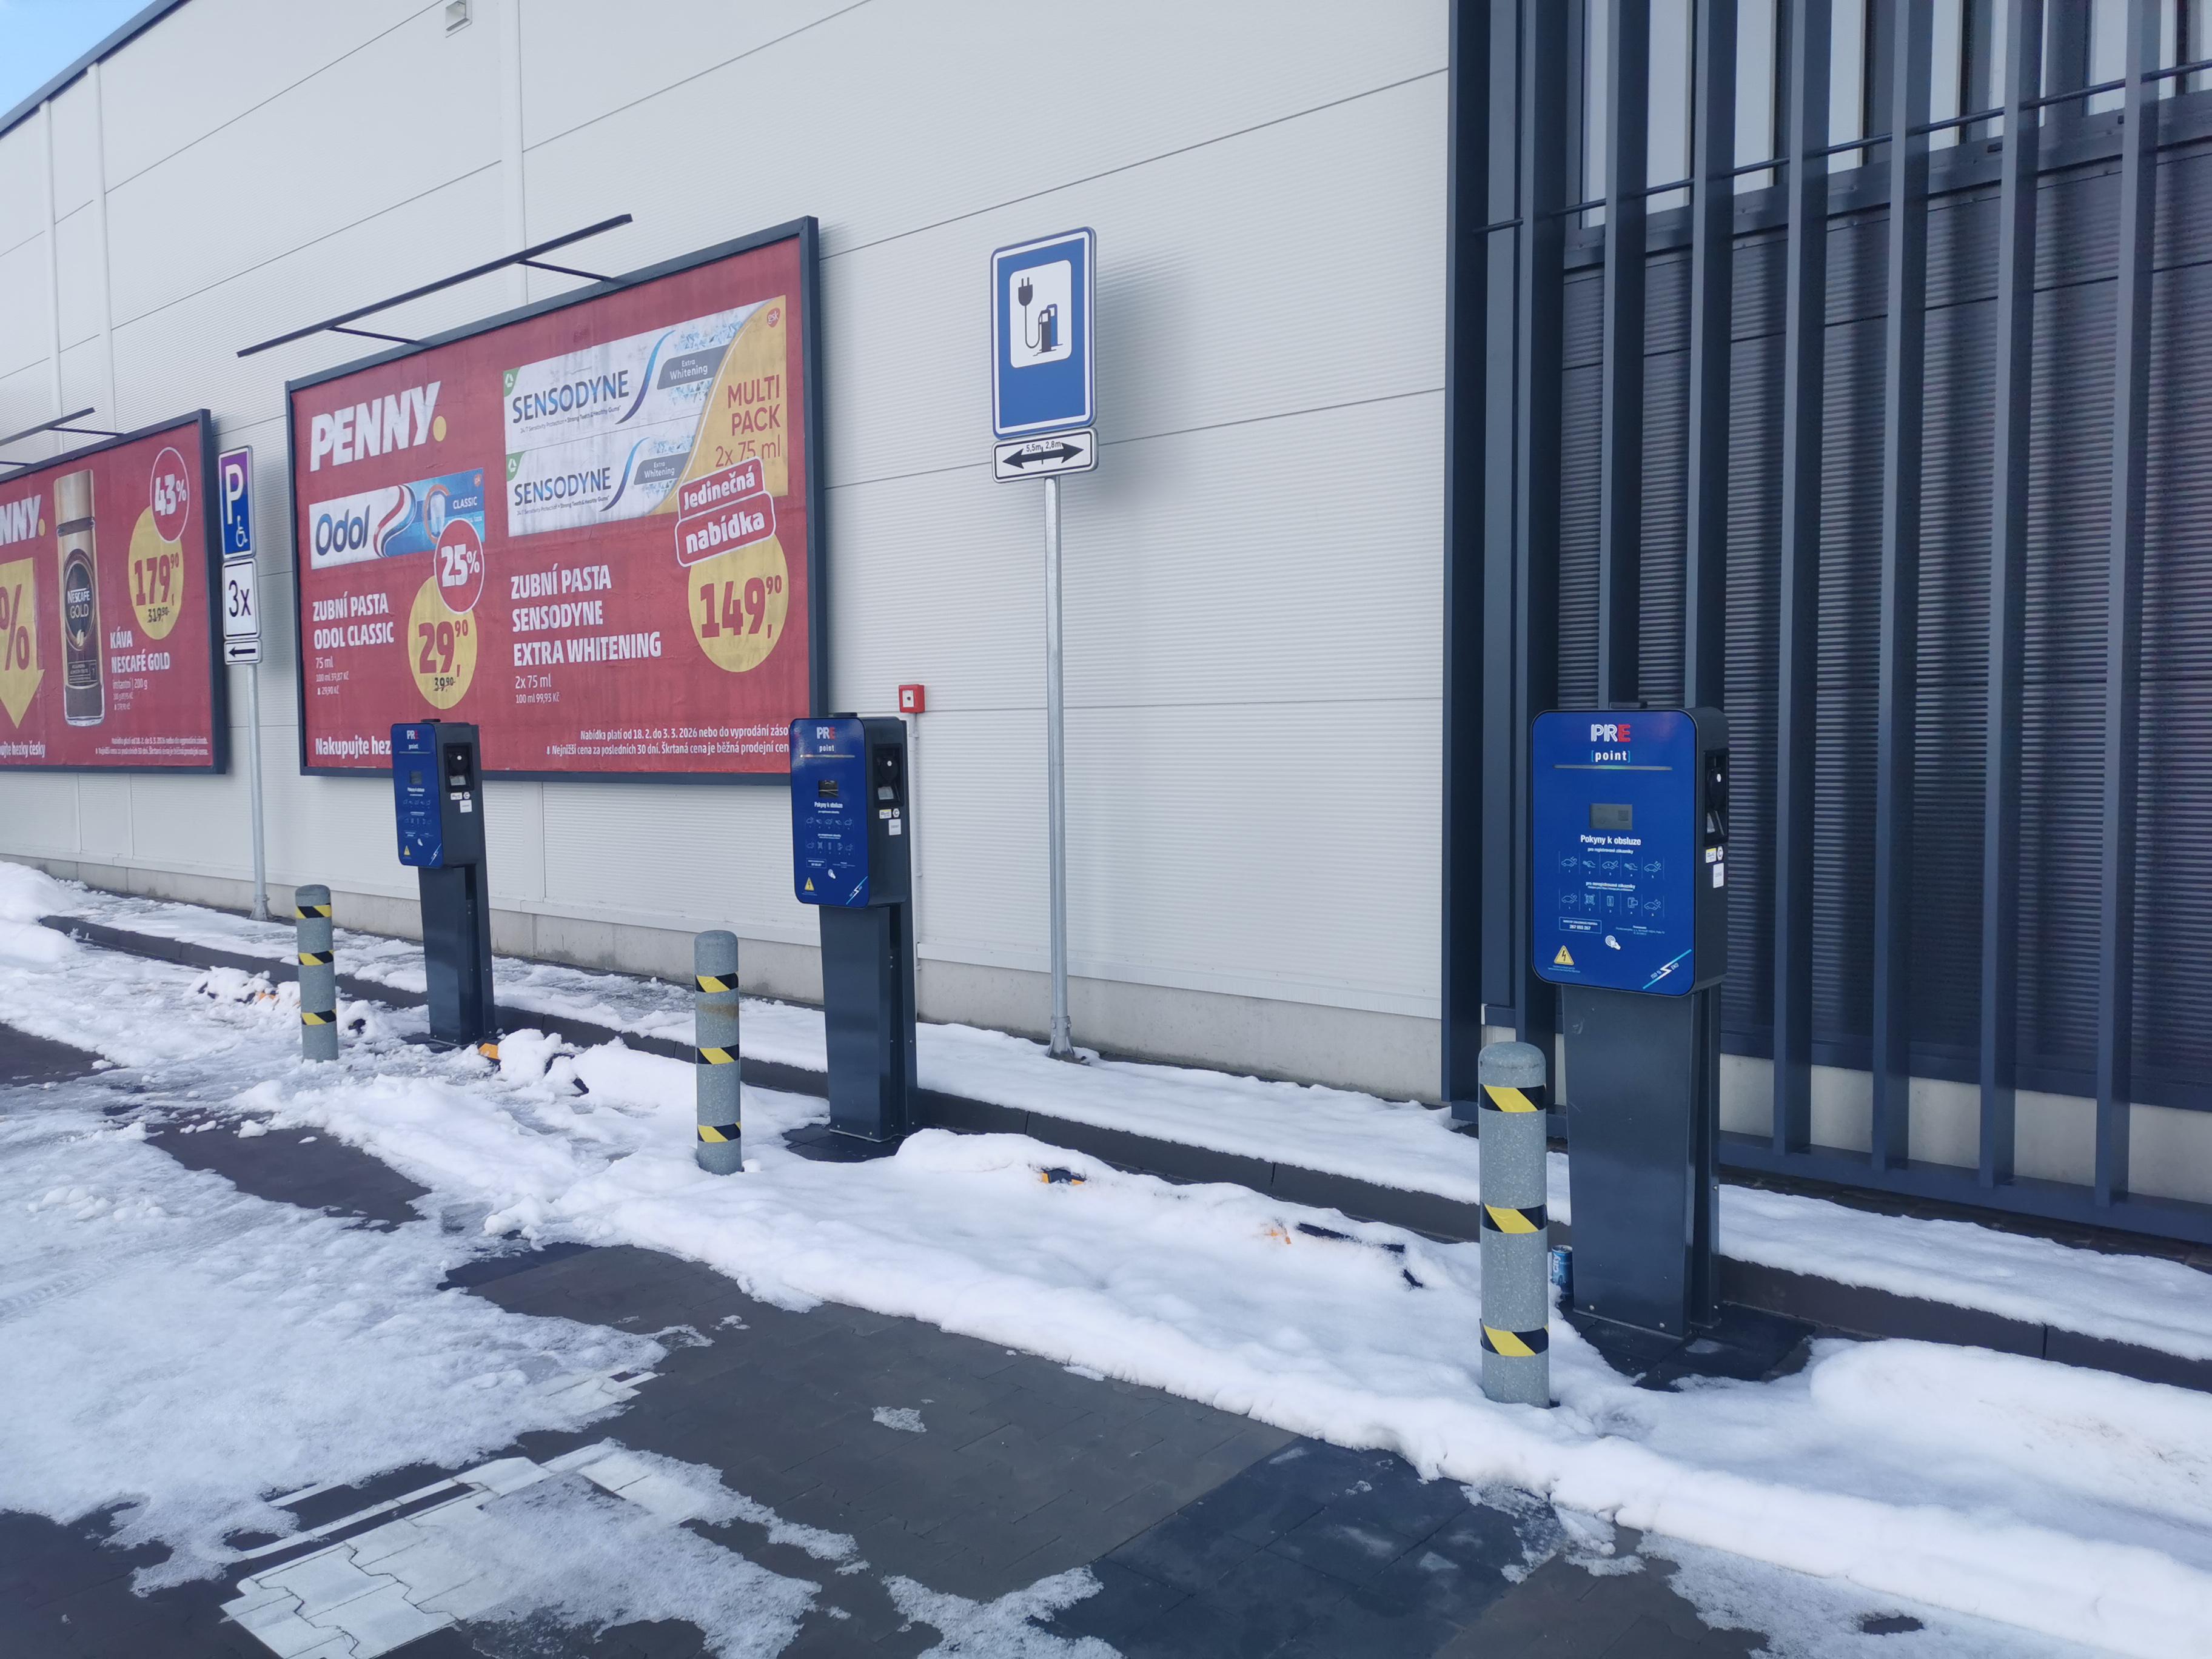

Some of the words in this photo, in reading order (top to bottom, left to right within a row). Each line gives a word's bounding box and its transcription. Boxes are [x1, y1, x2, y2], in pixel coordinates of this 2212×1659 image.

[669, 365, 708, 381] Whitening
[681, 358, 695, 367] Extra
[512, 370, 629, 424] SENSODYNE
[728, 374, 780, 409] MULTI
[731, 404, 781, 436] PACK
[715, 446, 732, 468] 2x
[739, 440, 756, 461] 75
[761, 435, 781, 459] ml
[1026, 444, 1041, 452] 5,5m
[1045, 440, 1061, 449] 2,8m
[644, 468, 675, 478] Whitening
[155, 473, 187, 516] 43%
[225, 464, 244, 525] P
[514, 467, 611, 506] SENSODYNE
[683, 465, 756, 511] Jedinečná
[453, 496, 478, 509] CLASSIC
[315, 504, 370, 557] Odol
[685, 510, 765, 555] nabídka
[441, 543, 480, 588] 25%
[511, 563, 558, 600] ZUBNÍ
[561, 565, 612, 594] PASTA
[70, 604, 89, 619] GOLD
[312, 591, 348, 622] ZUBNÍ
[350, 592, 389, 618] PASTA
[512, 600, 603, 632] SENSODYNE
[110, 626, 133, 649] KÁVA
[313, 627, 346, 650] ODOL
[347, 622, 394, 646] CLASSIC
[514, 640, 565, 666] EXTRA
[566, 631, 662, 663] WHITENING
[112, 648, 147, 673] NESCAFÉ
[147, 652, 170, 671] GOLD
[315, 657, 324, 669] 75
[324, 655, 333, 668] ml
[515, 676, 526, 689] 2x
[527, 675, 538, 689] 75
[540, 674, 552, 688] ml
[515, 695, 526, 704] 100
[527, 694, 535, 703] ml
[552, 692, 560, 703] Kč
[580, 729, 606, 740] Nabídka
[607, 728, 622, 741] platí
[623, 729, 632, 739] od
[633, 729, 644, 739] 18.
[645, 729, 652, 739] 2.
[652, 728, 662, 739] do
[663, 728, 670, 739] 3.
[671, 728, 678, 739] 3.
[679, 727, 697, 738] 2026
[699, 726, 718, 737] nebo
[719, 726, 728, 737] do
[729, 724, 769, 739] vyprodání
[770, 724, 790, 736] záso
[816, 726, 835, 739] PRE
[1590, 723, 1631, 742] PRE
[315, 734, 369, 759] Nakupujte
[371, 736, 391, 755] hez
[552, 743, 577, 757] Nejnižší
[577, 746, 592, 755] cena
[593, 746, 600, 755] za
[602, 743, 636, 757] posledních
[637, 744, 646, 754] 30
[647, 742, 661, 754] dní.
[662, 740, 689, 754] Škrtaná
[690, 745, 705, 754] cena
[706, 742, 716, 756] je
[717, 740, 739, 753] běžná
[740, 740, 774, 756] prodejní
[775, 743, 789, 752] cen
[1580, 834, 1606, 845] Pokyny
[1614, 837, 1642, 846] obsluze
